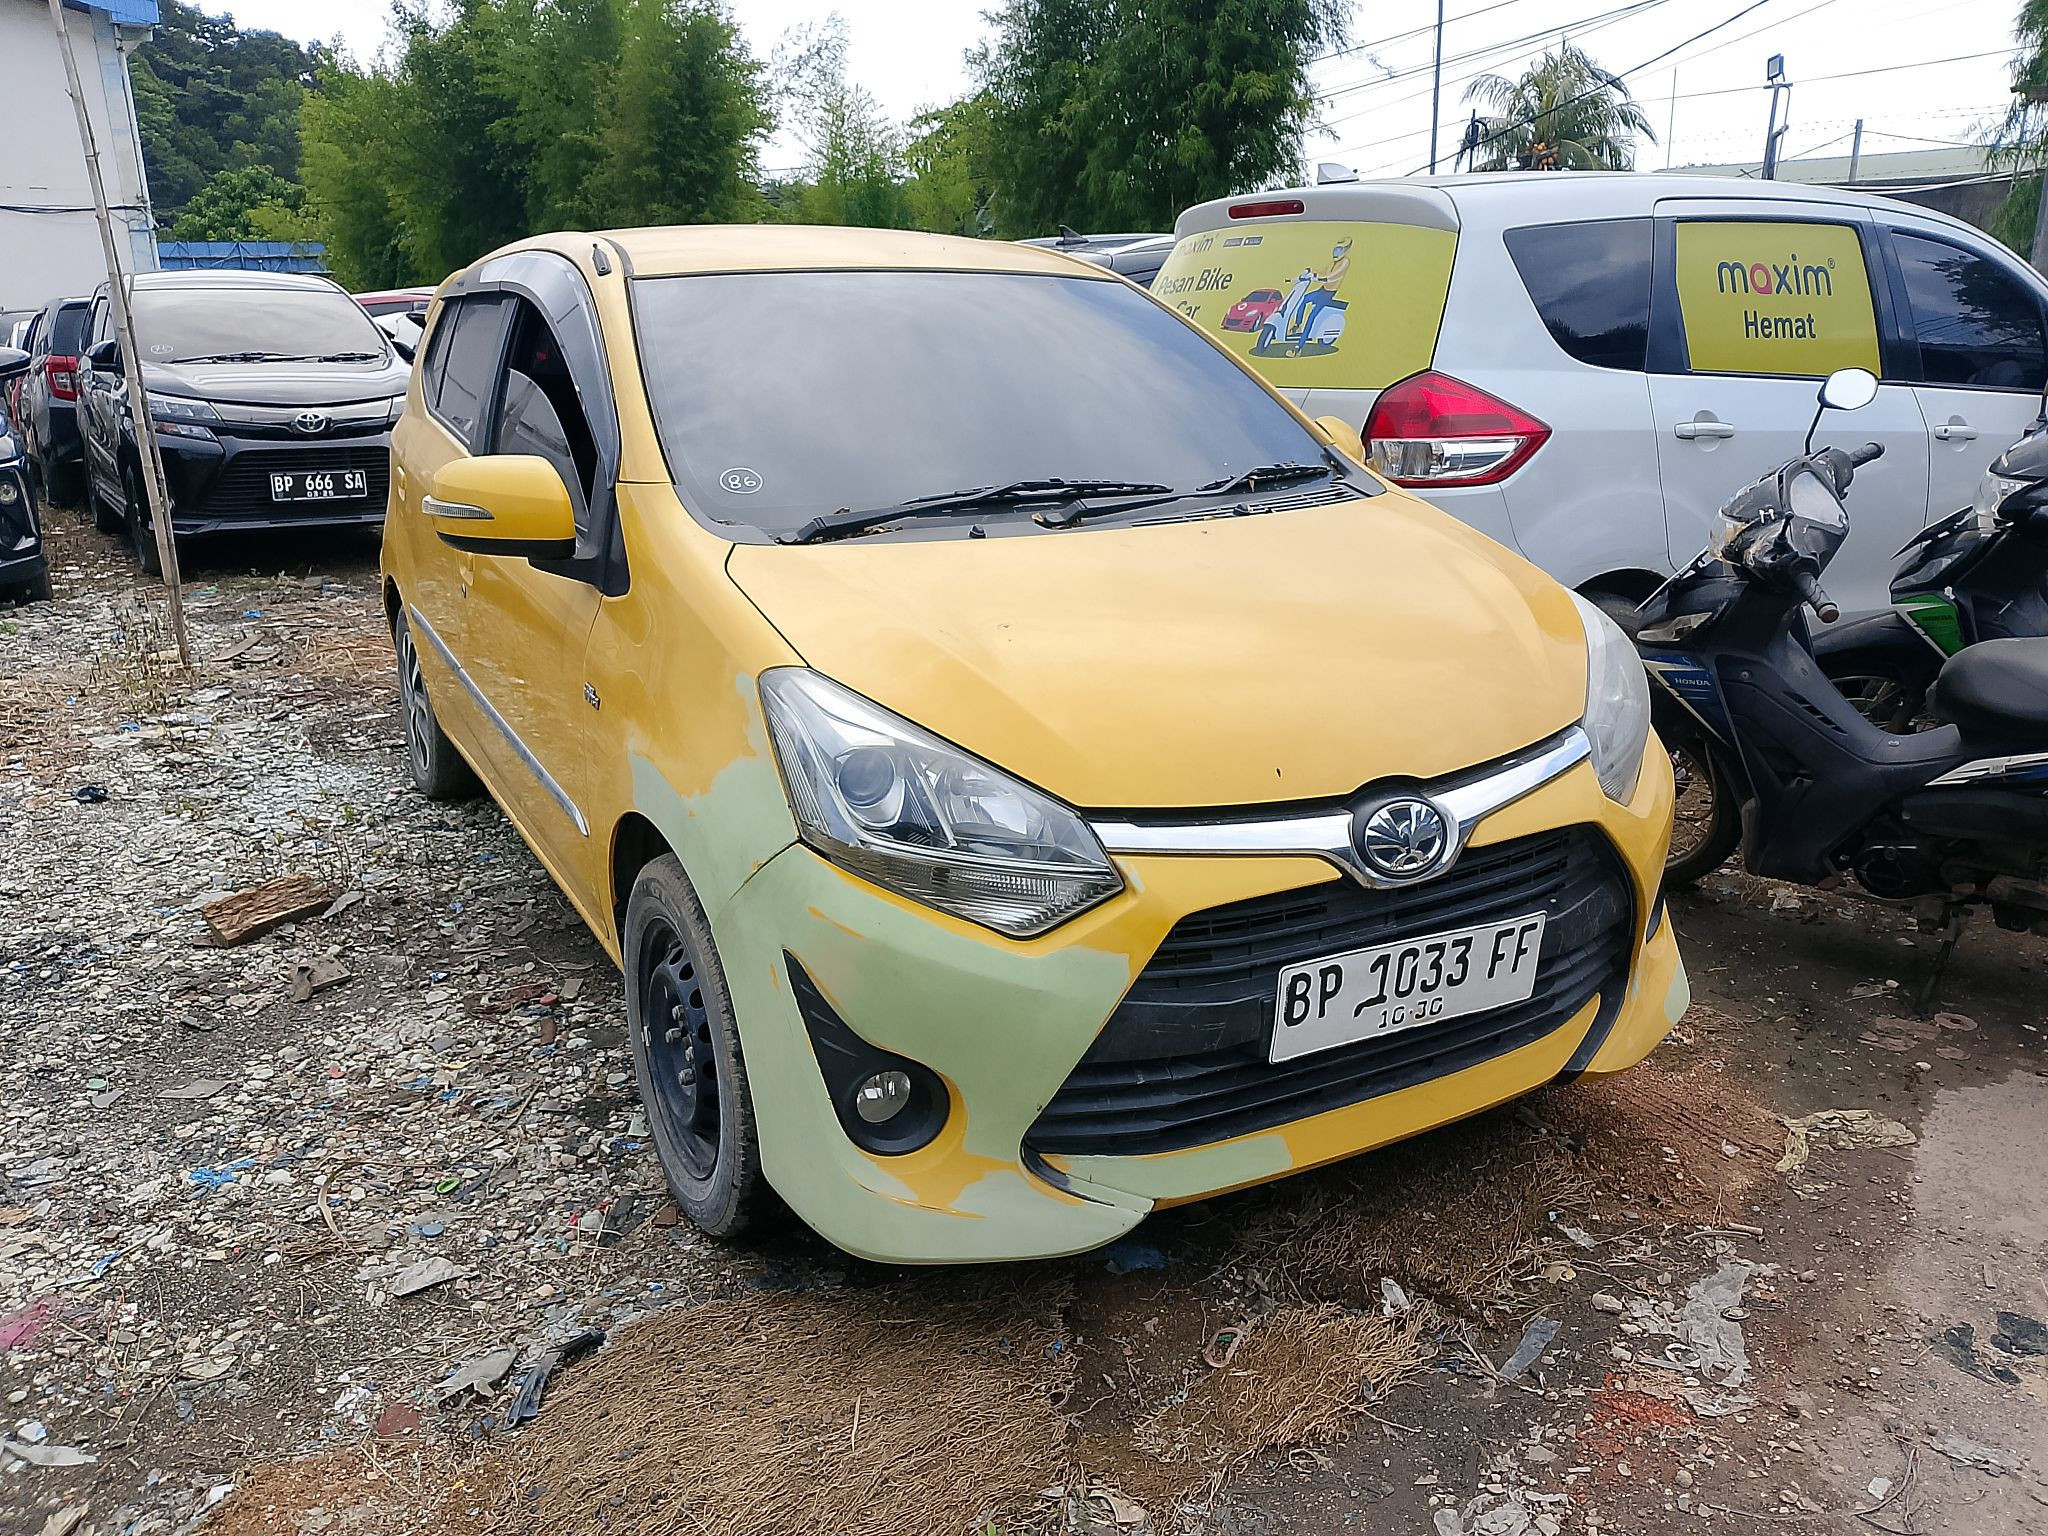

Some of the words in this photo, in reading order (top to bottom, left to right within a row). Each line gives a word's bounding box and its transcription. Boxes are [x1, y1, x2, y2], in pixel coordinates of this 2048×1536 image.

[1156, 275, 1195, 296] Pesan
[1195, 267, 1233, 291] Bike
[1744, 310, 1817, 339] Hemat
[274, 476, 293, 492] BP
[305, 474, 333, 490] 666
[344, 473, 363, 489] SA
[728, 474, 757, 489] 86
[1674, 678, 1711, 686] HONDA
[1284, 963, 1344, 1027] BP
[1353, 936, 1475, 1018] 1033
[1487, 922, 1538, 979] FF
